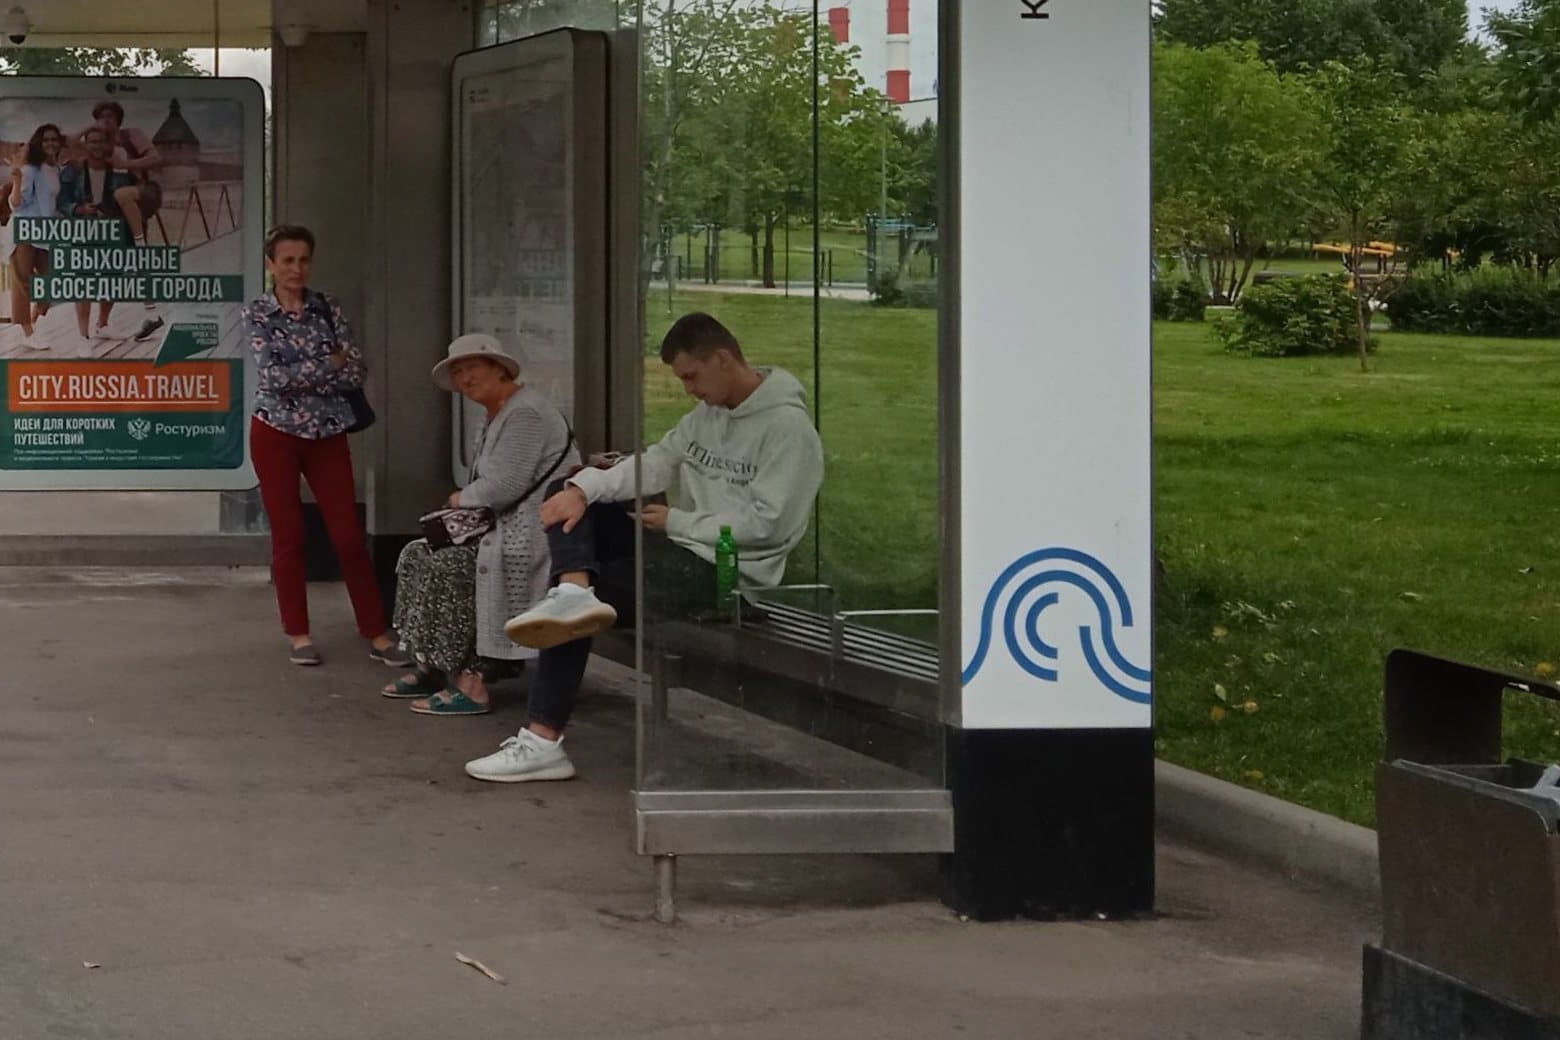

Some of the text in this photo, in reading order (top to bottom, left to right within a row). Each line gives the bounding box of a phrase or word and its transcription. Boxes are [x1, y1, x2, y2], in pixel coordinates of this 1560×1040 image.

[18, 218, 121, 244] ВЫХОДИТЕ
[53, 248, 178, 273] В ВЫХОДНЫЕ
[33, 277, 224, 302] В СОСЕДНИЕ ГОРОДА
[18, 374, 220, 400] CITY.RUSSIA.TRAVEL
[14, 418, 116, 432] ИДЕИ ДЛЯ КОРОТКИХ
[155, 422, 226, 439] Ростуризм
[14, 432, 85, 446] ПУТЕШЕСТВИЙ
